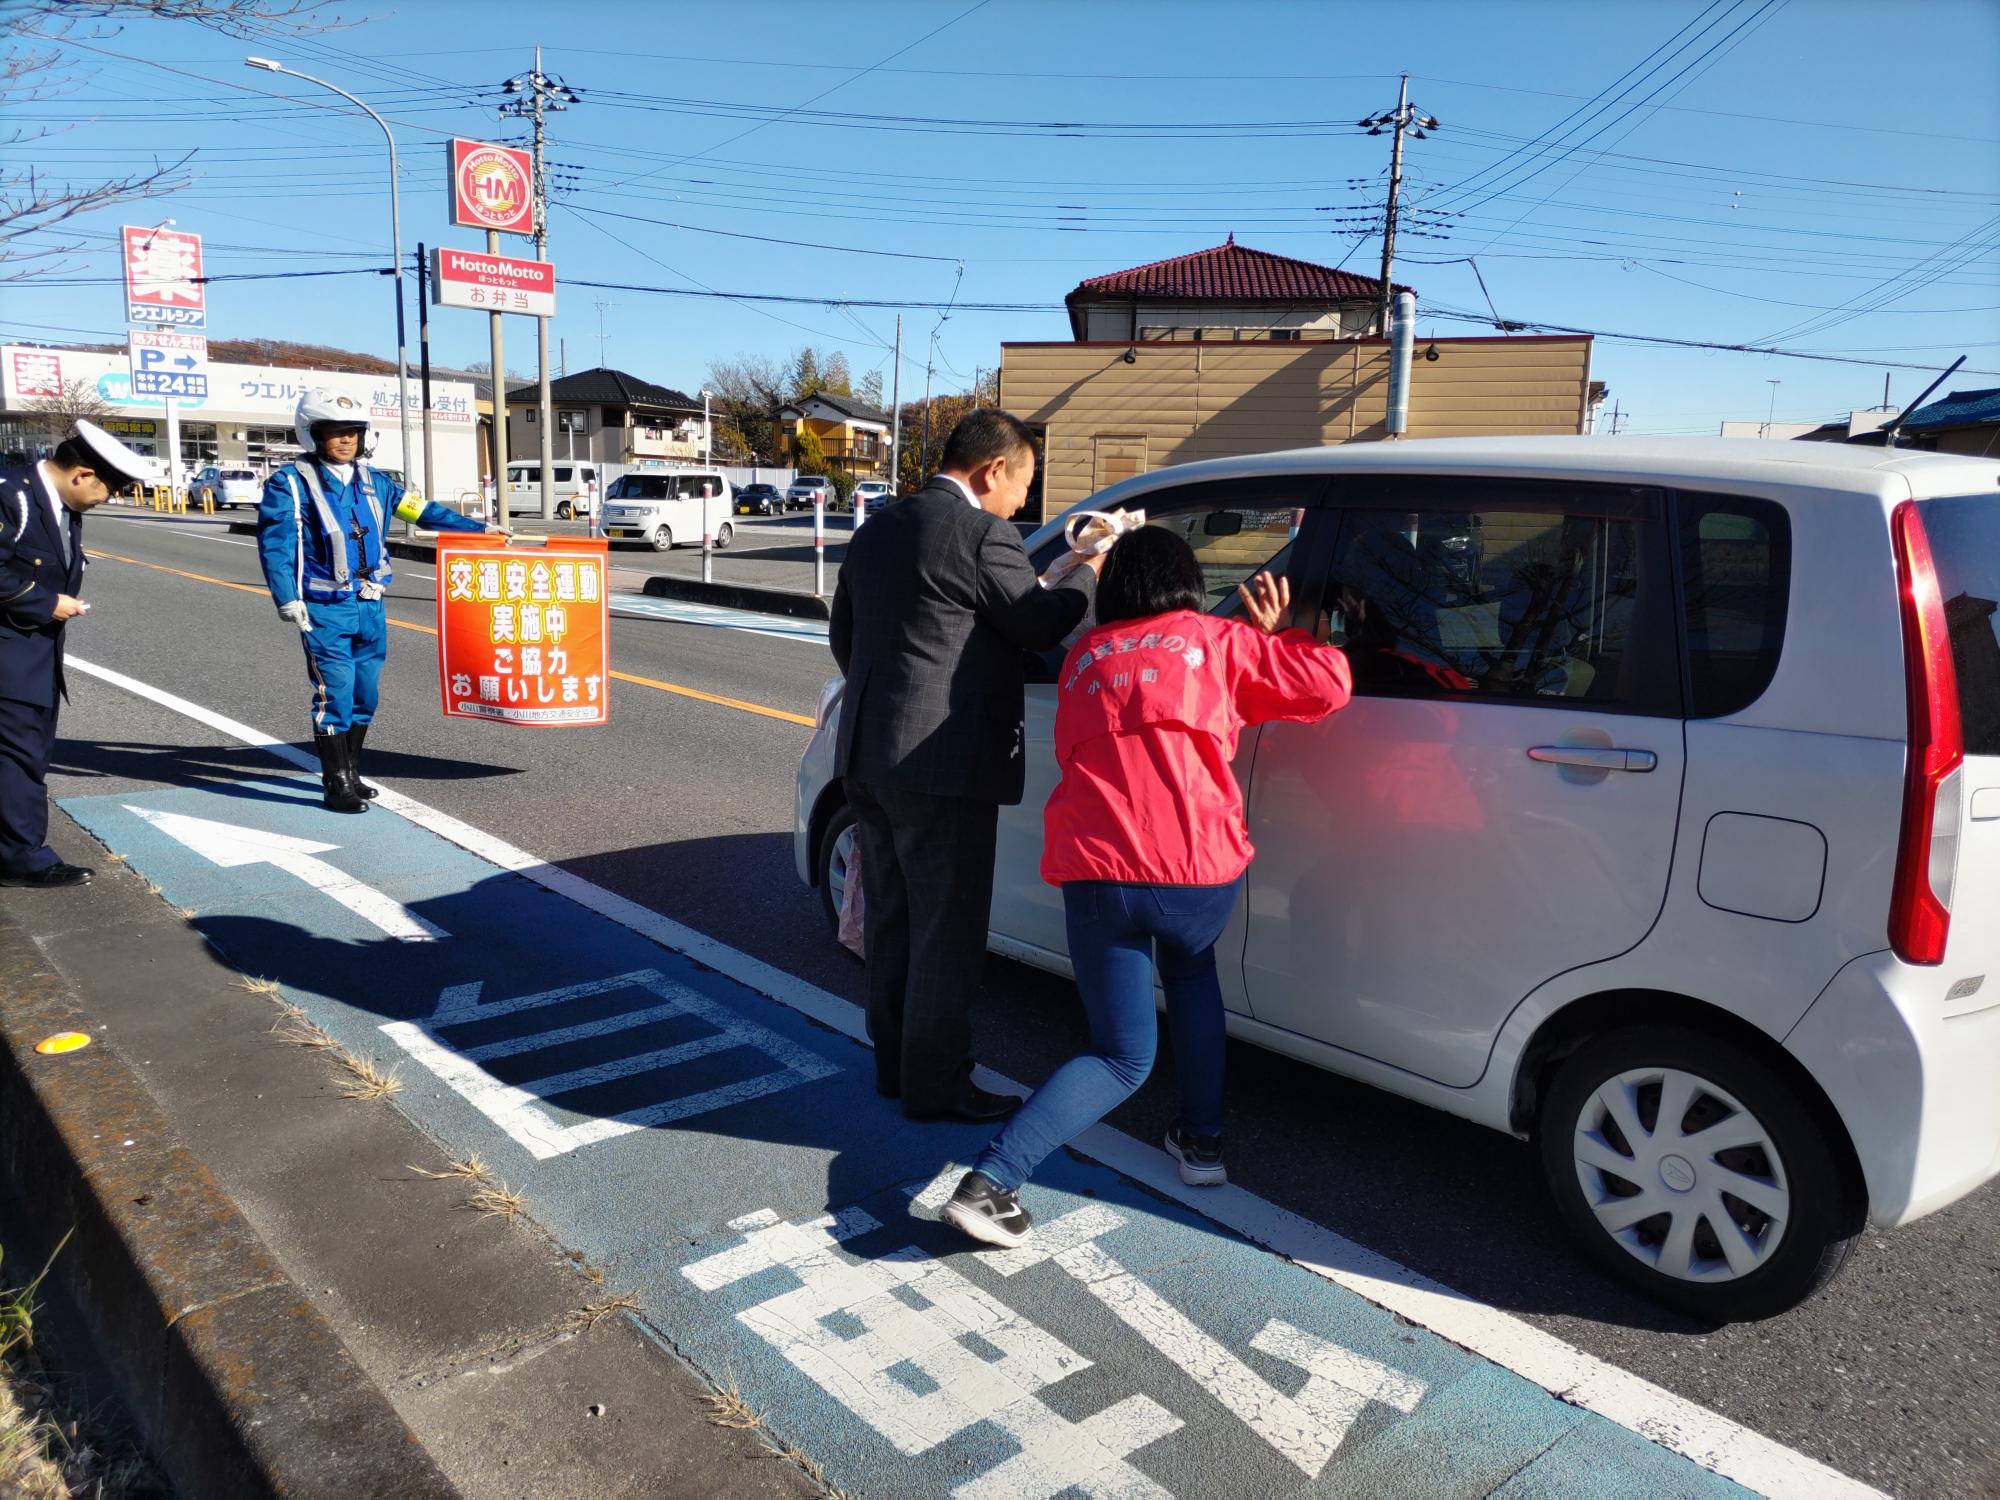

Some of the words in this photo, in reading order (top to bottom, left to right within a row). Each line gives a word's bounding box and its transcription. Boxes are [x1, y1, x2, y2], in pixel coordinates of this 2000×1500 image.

[469, 172, 520, 205] HM
[474, 203, 517, 221] ほっともっと
[130, 235, 201, 302] 薬
[478, 275, 518, 287] ほっともっと
[471, 287, 529, 309] お弁当
[131, 305, 204, 324] ウエルシア
[132, 333, 205, 350] 処方せん受付
[139, 348, 166, 370] P
[16, 354, 61, 394] 薬
[158, 375, 186, 394] 24
[372, 390, 468, 413] 処方せ受付
[448, 559, 599, 603] 交通安全運動
[491, 602, 567, 643] 実施中
[494, 647, 567, 676] ご協力
[452, 673, 600, 703] お願いします
[1087, 668, 1159, 695] 小川町
